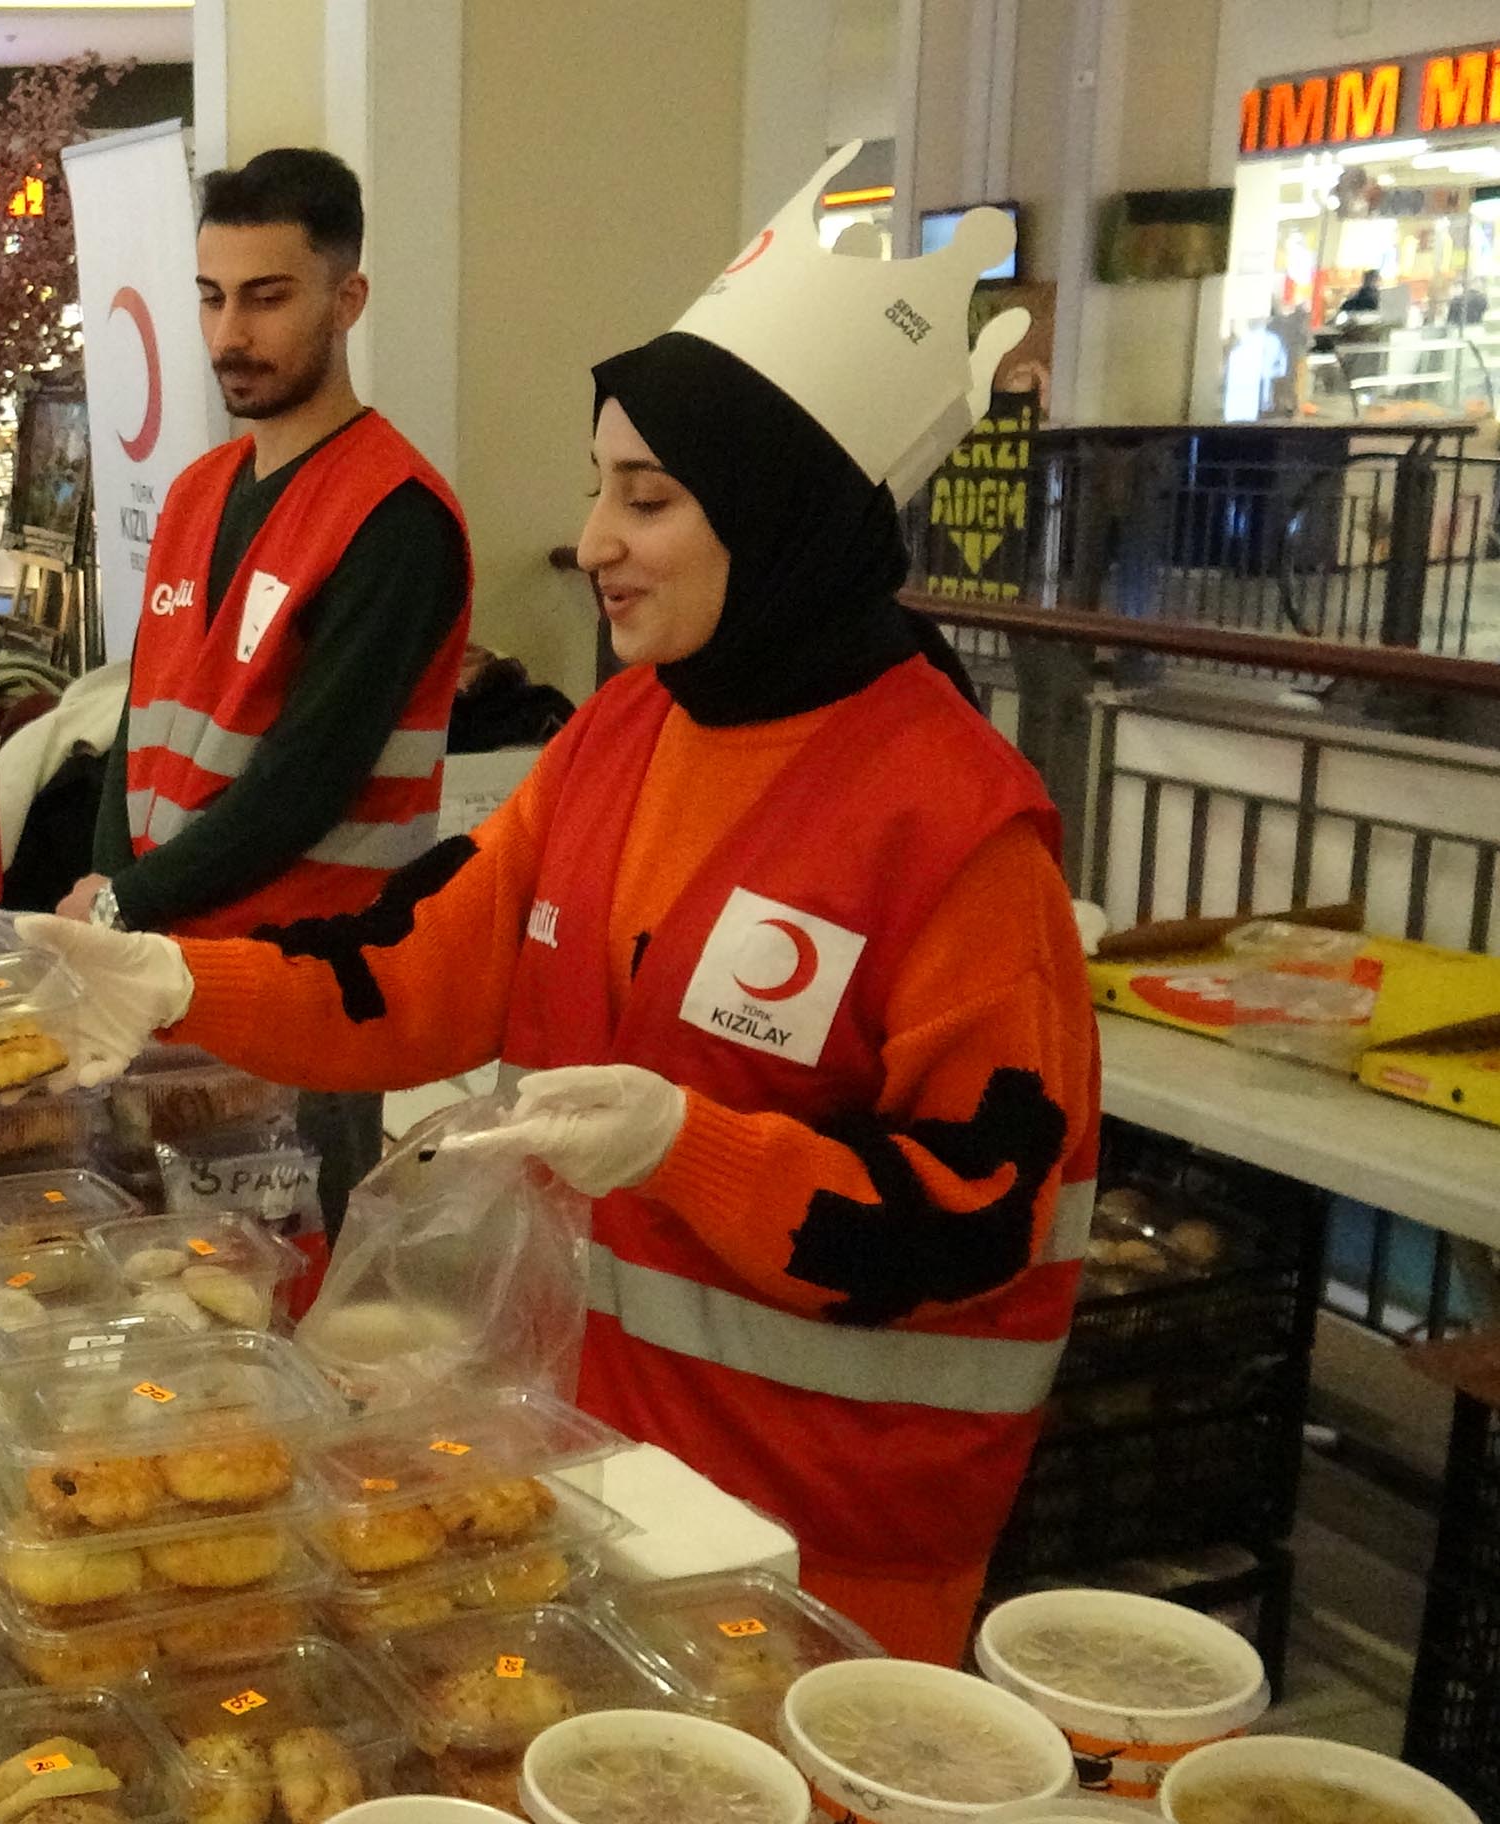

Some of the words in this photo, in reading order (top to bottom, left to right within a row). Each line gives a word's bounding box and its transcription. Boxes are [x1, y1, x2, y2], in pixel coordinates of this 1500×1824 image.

[710, 1006, 793, 1047] KIZILAY
[230, 1695, 257, 1710] 20
[33, 1760, 56, 1772] 20
